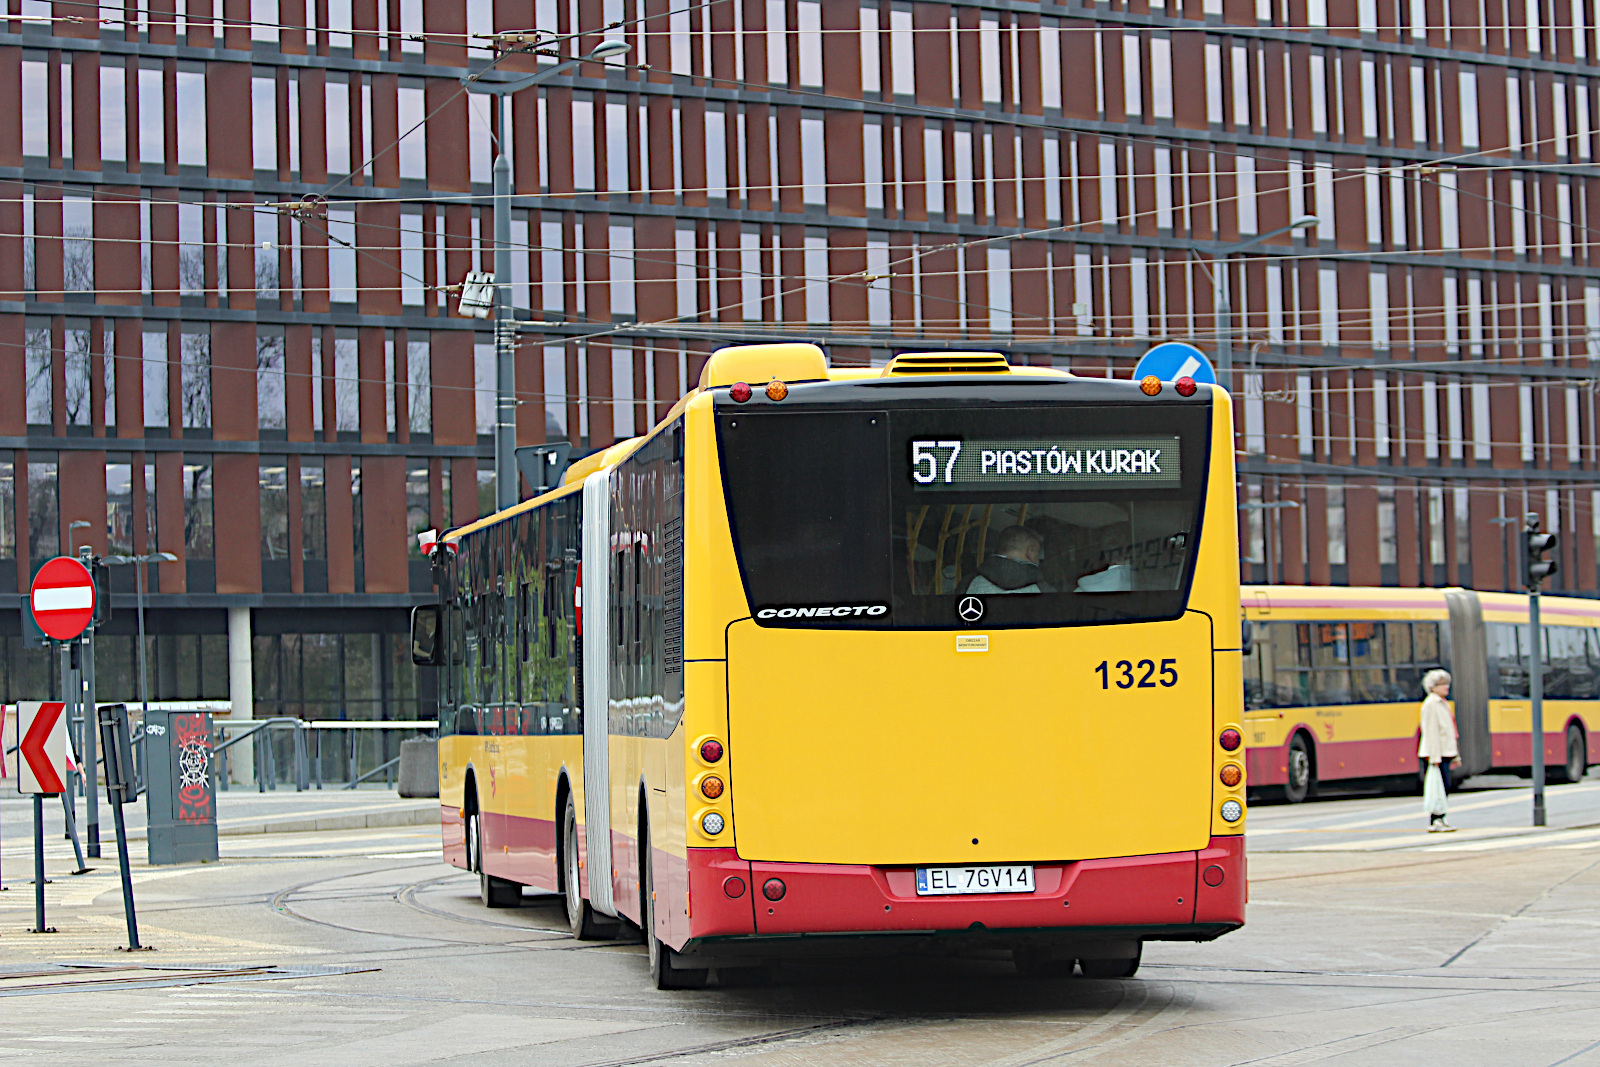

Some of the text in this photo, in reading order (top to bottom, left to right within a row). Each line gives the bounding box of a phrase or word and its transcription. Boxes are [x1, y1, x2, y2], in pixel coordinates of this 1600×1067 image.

[912, 441, 1161, 483] 57 PIASTÓW KURAK
[757, 605, 887, 619] CONECTO
[1094, 658, 1178, 690] 1325
[932, 868, 1027, 888] EL 7GV14
